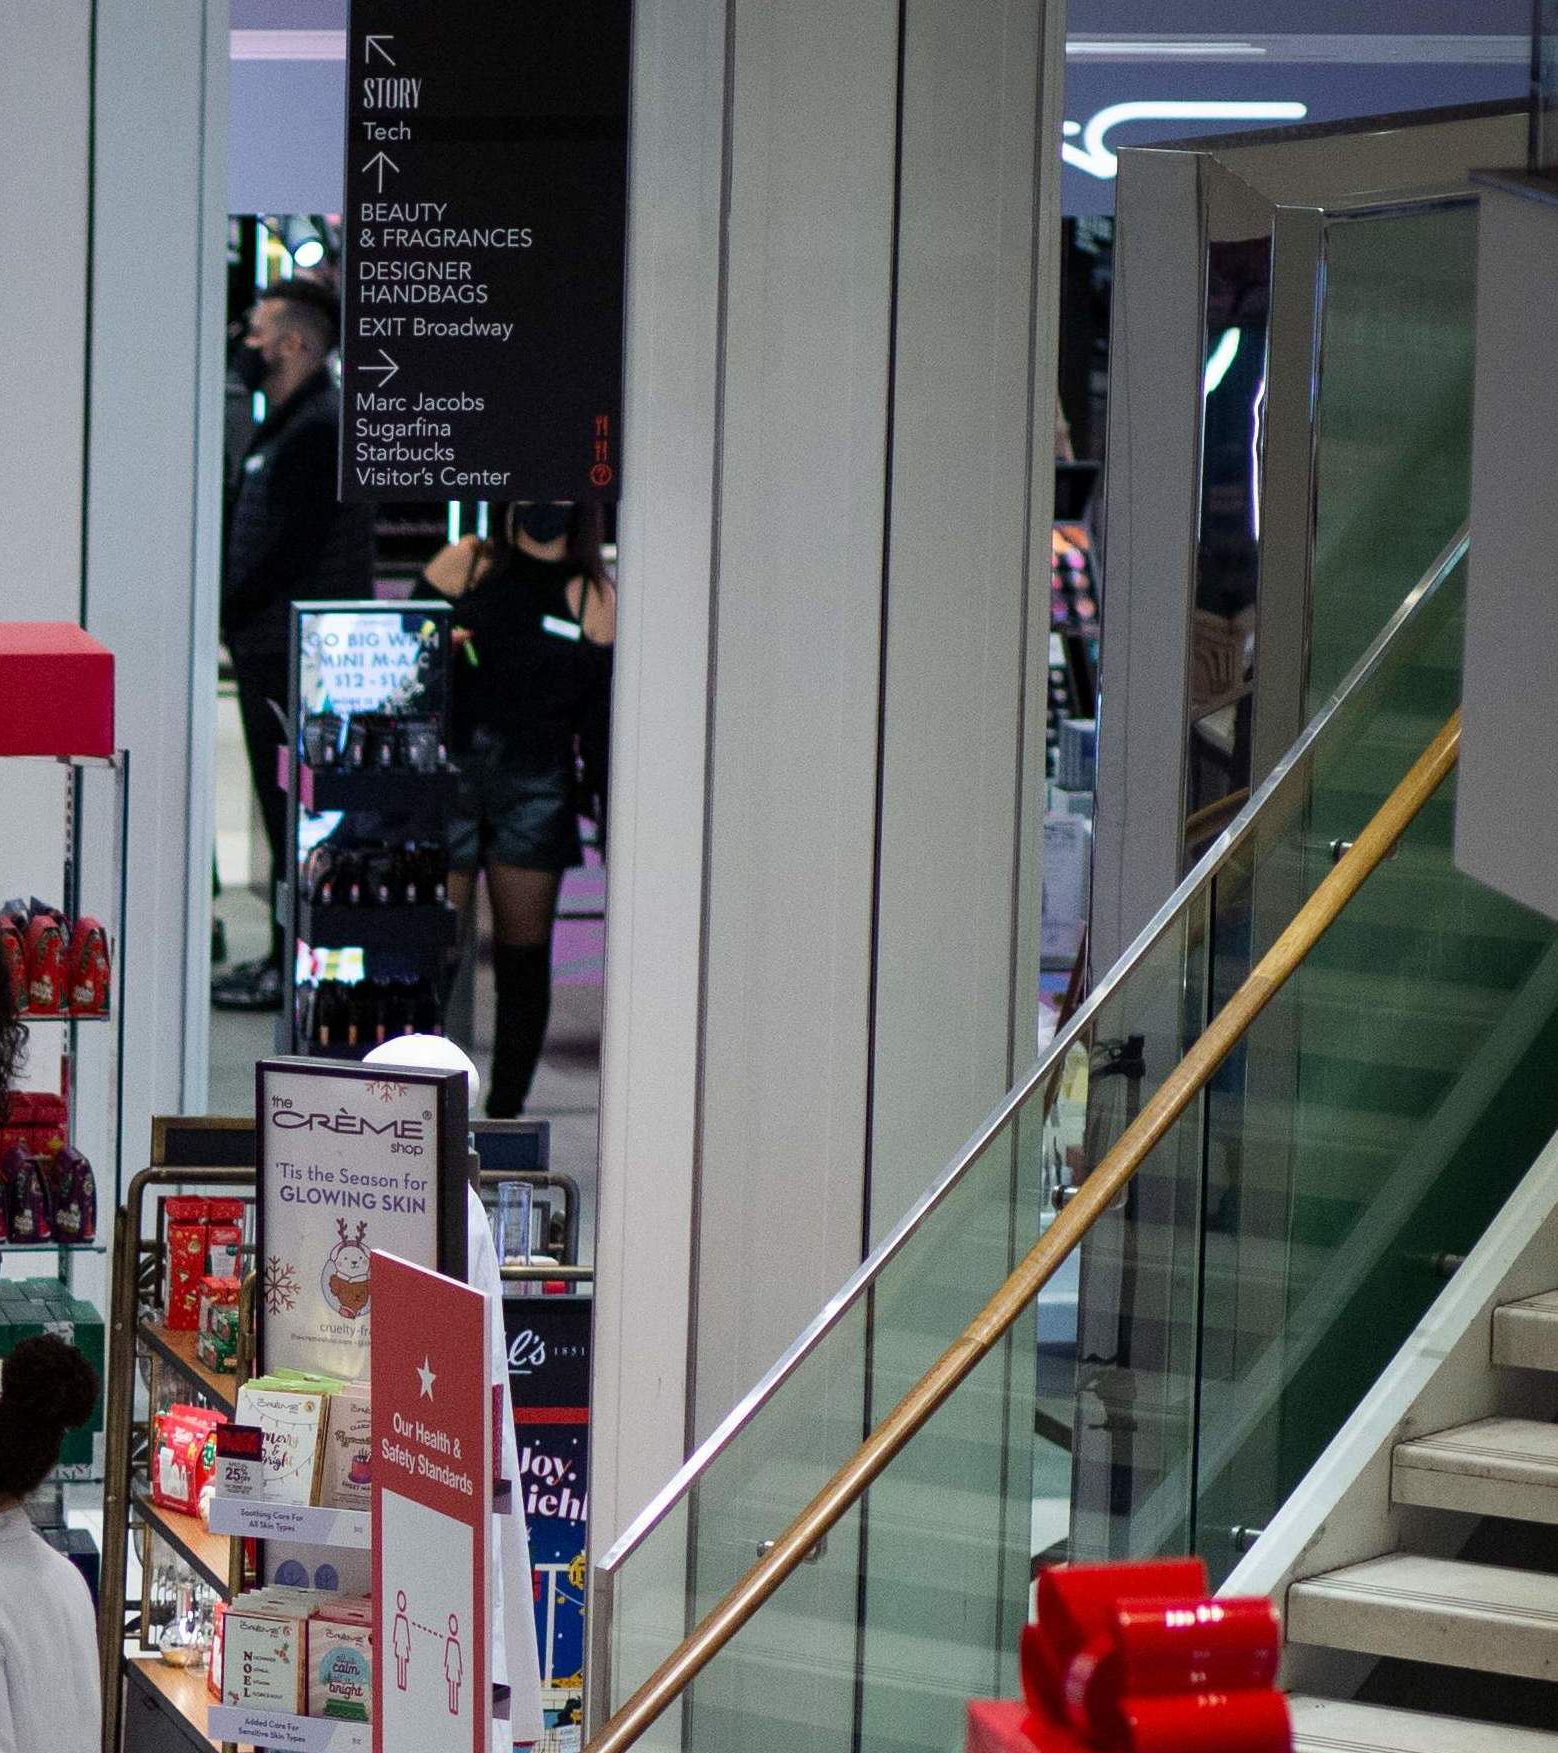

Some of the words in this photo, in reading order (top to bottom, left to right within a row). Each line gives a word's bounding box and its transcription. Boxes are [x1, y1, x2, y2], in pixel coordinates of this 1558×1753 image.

[363, 77, 422, 109] STORY
[363, 121, 411, 140] Tech
[360, 202, 448, 222] BEAUTY
[359, 228, 375, 248] &
[383, 228, 533, 248] FRAGRANCES
[359, 261, 472, 281] DESIGNER
[360, 284, 488, 304] HANDBAGS
[359, 317, 406, 336] EXIT
[412, 316, 514, 341] Broadway
[356, 392, 407, 412] Marc
[412, 392, 485, 412] Jacobs
[355, 417, 451, 442] Sugarfina
[356, 442, 455, 462] Starbucks
[356, 467, 434, 486] Visitor's
[439, 466, 512, 486] Center
[347, 632, 380, 648] BIG
[321, 653, 364, 669] MINI
[272, 1096, 292, 1109] the
[272, 1107, 424, 1140] CRÈME
[390, 1141, 424, 1157] shop
[308, 1165, 334, 1183] the
[339, 1167, 398, 1189] Season
[403, 1173, 428, 1192] for
[280, 1185, 376, 1210] GLOWING
[381, 1194, 426, 1214] SKIN
[320, 1322, 370, 1337] cruelty-fr
[393, 1411, 414, 1438] Our
[415, 1421, 451, 1455] Health
[452, 1438, 462, 1460] &
[381, 1437, 416, 1475] Safety
[417, 1454, 474, 1496] Standards
[241, 1508, 272, 1520] Soothing
[273, 1511, 290, 1521] Care
[260, 1521, 275, 1530] Skin
[332, 1662, 361, 1677] calm
[328, 1683, 363, 1700] bright
